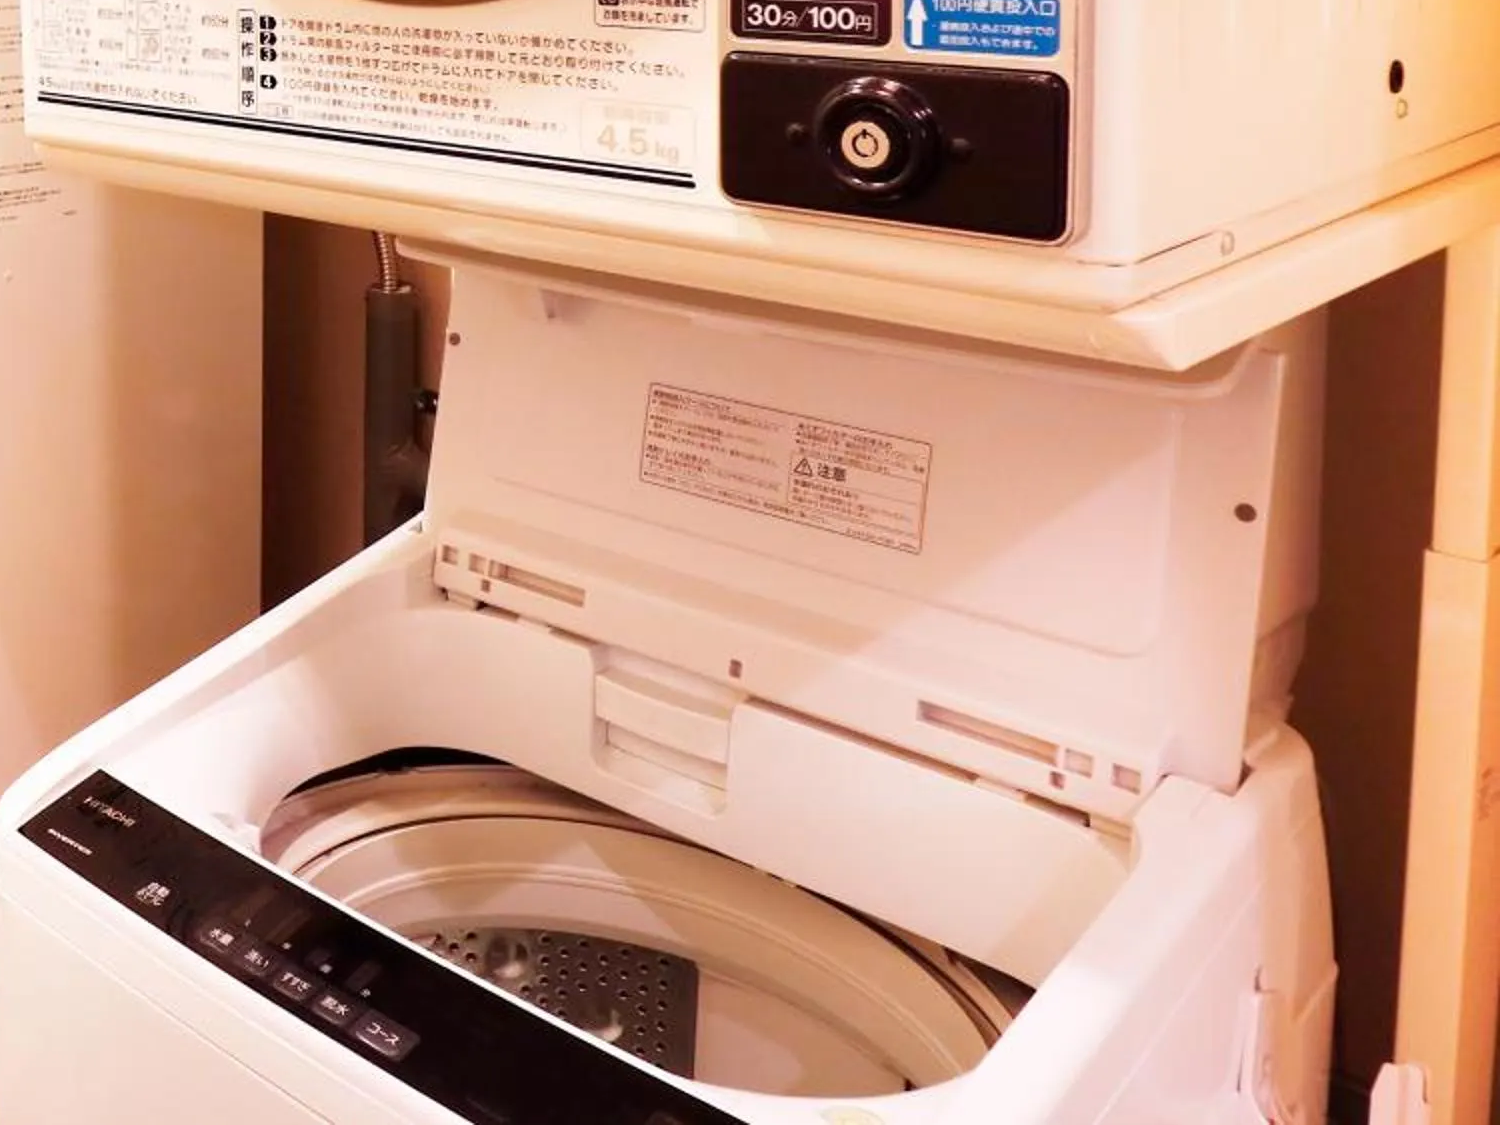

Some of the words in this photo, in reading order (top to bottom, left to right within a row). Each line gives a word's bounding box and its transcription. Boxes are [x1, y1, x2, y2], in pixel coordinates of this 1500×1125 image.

[241, 16, 255, 108] 操作順序
[597, 124, 648, 156] 4.5
[818, 462, 846, 482] 注意
[83, 796, 136, 828] HITACHI
[320, 994, 350, 1016] 脱水
[365, 1021, 400, 1046] コース
